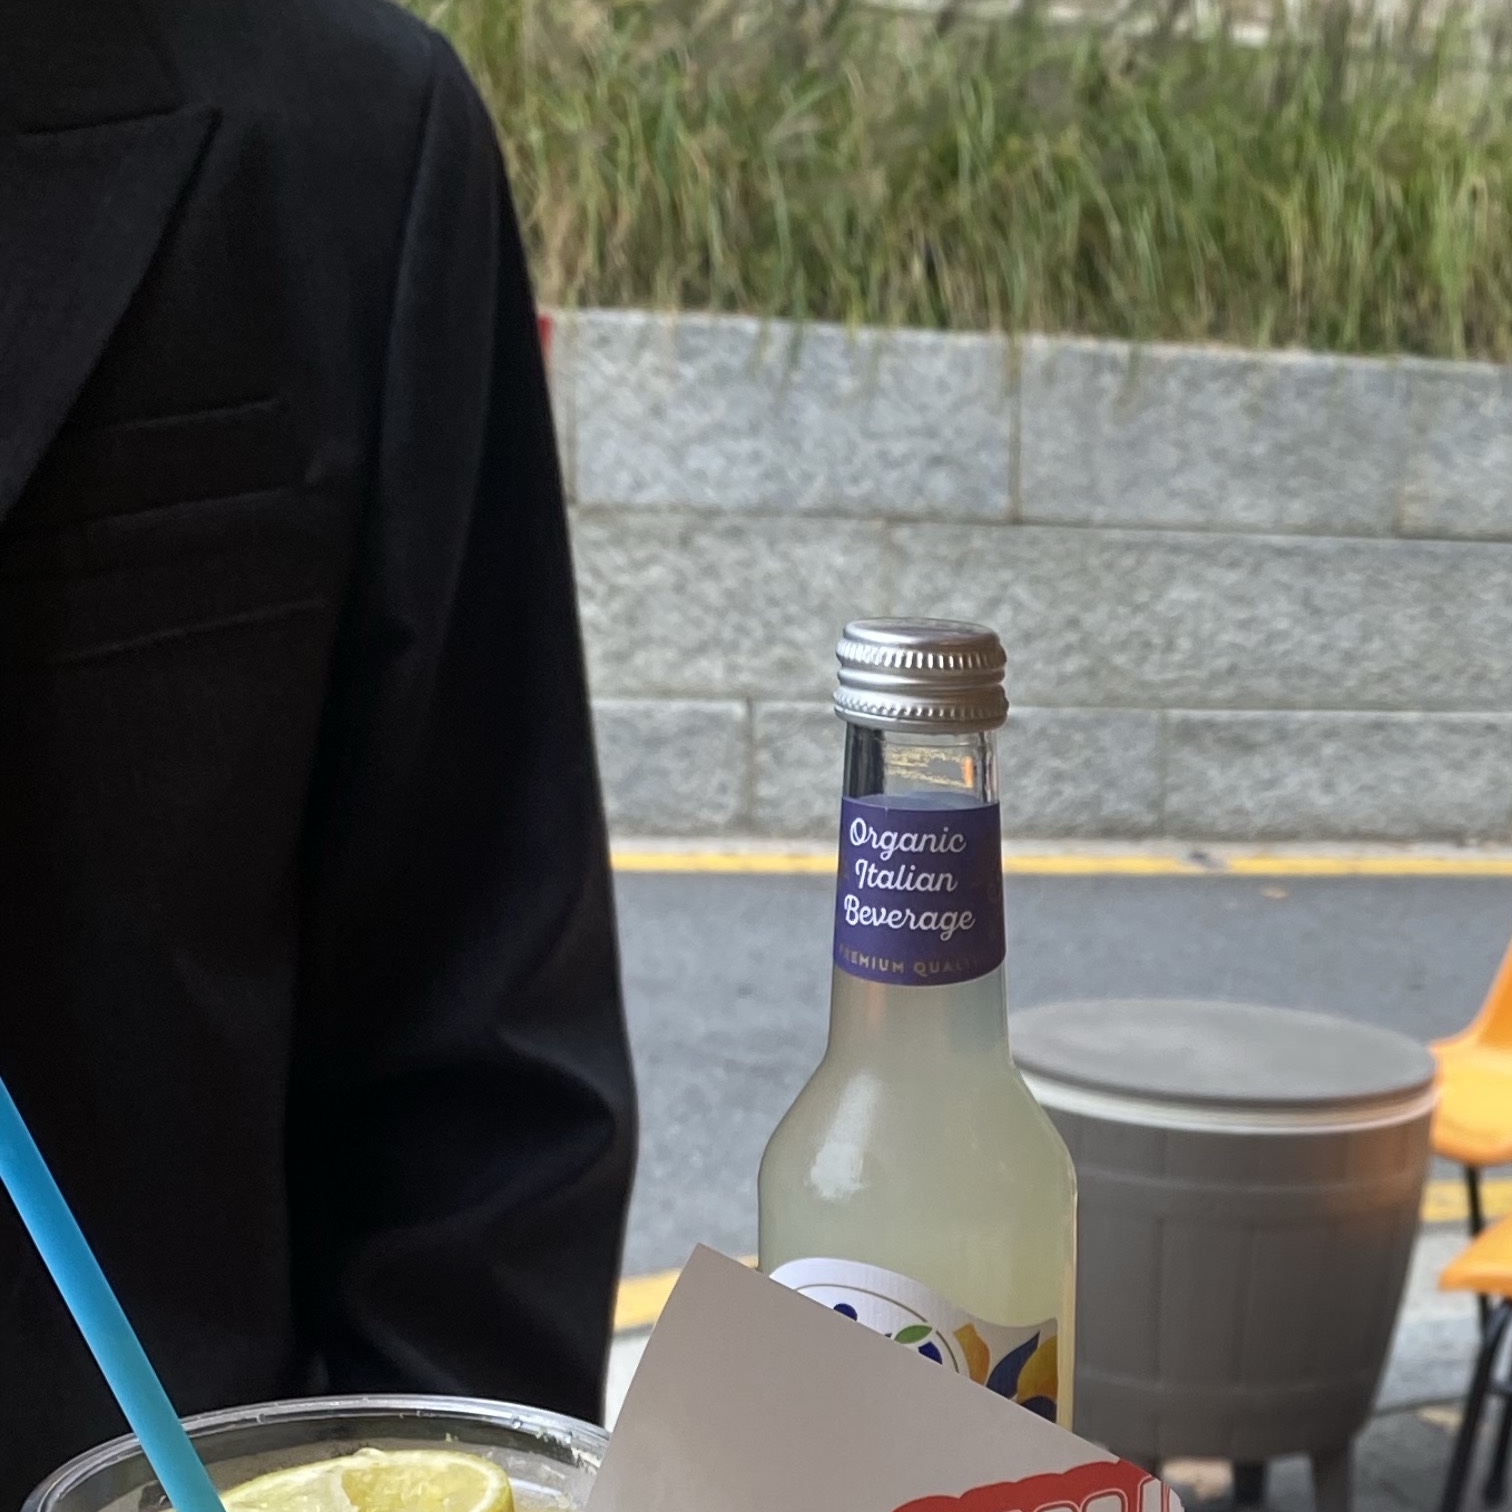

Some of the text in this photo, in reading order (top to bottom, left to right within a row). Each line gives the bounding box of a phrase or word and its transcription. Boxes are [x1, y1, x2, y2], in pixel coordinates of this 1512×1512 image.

[849, 816, 967, 861] Organic
[855, 858, 958, 892] Italian
[843, 894, 976, 941] Beverage
